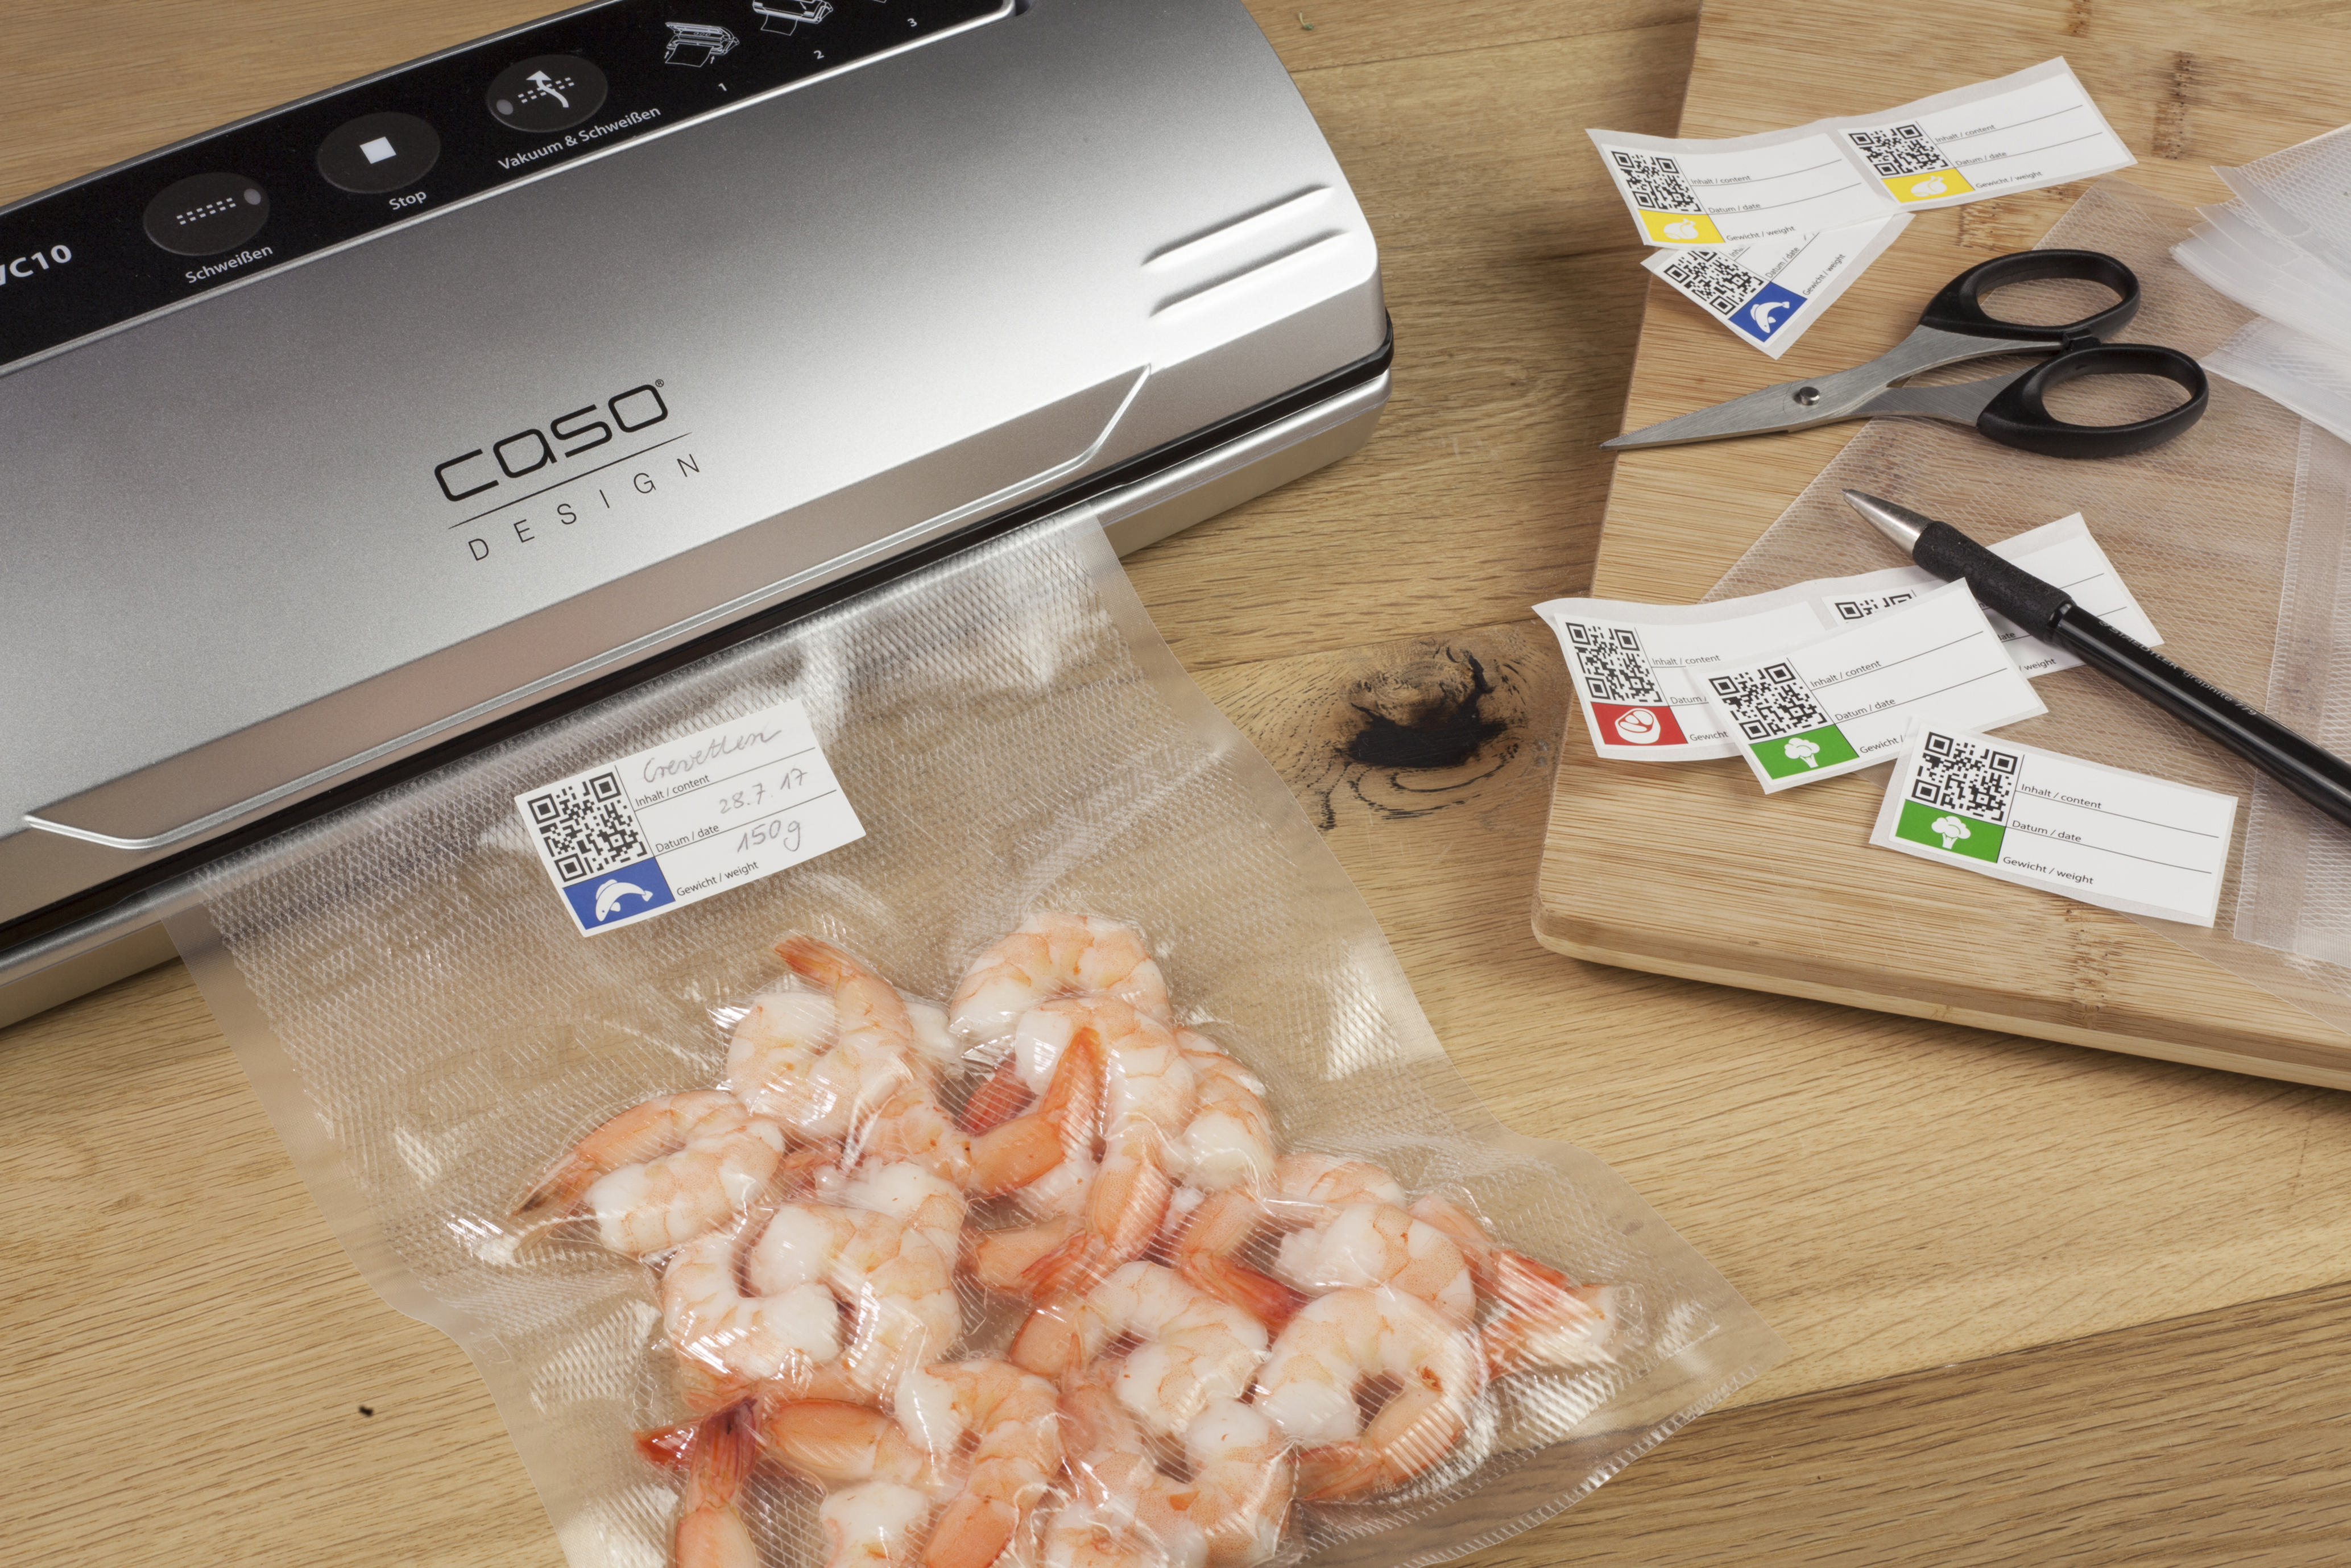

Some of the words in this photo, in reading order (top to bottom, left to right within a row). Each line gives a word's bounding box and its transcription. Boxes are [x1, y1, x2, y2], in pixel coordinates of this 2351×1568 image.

[907, 18, 917, 27] 3
[813, 50, 825, 59] 2
[718, 82, 727, 92] 1
[498, 142, 564, 170] Vakuum
[565, 136, 577, 146] &
[578, 107, 661, 142] Schweißen
[1935, 134, 1958, 143] Inhalt
[1965, 125, 1996, 135] content
[1955, 157, 1982, 166] Datum
[1720, 175, 1751, 184] content
[1975, 177, 2009, 189] Gewicht
[2015, 170, 2043, 181] weight
[389, 191, 427, 210] Stop
[1727, 233, 1760, 241] Gewicht
[1766, 226, 1796, 235] weight
[185, 246, 273, 283] Schweißen
[1765, 262, 1785, 279] Datum
[1786, 246, 1800, 259] date
[1802, 274, 1824, 296] Gewicht
[1828, 254, 1846, 272] weight
[469, 454, 699, 561] DESIGN
[1685, 654, 1721, 664] content
[2024, 658, 2057, 671] weight
[1810, 673, 1837, 688] Inhalt
[1845, 660, 1882, 677] content
[2183, 670, 2232, 702] graphite
[1671, 696, 1702, 705] Datum
[1835, 706, 1868, 721] Datum
[1874, 697, 1896, 710] date
[1690, 730, 1728, 742] Gewicht
[1860, 738, 1899, 754] Gewicht
[635, 790, 664, 806] Inhalt
[673, 775, 710, 794] content
[2021, 784, 2052, 797] Inhalt
[2061, 795, 2102, 809] content
[655, 835, 689, 853] Datum
[698, 825, 719, 838] date
[2012, 820, 2048, 835] Datum
[2058, 830, 2082, 842] date
[676, 876, 718, 896] Gewicht
[724, 861, 759, 880] weight
[2003, 857, 2047, 874] Gewicht
[2056, 870, 2094, 885] weight
